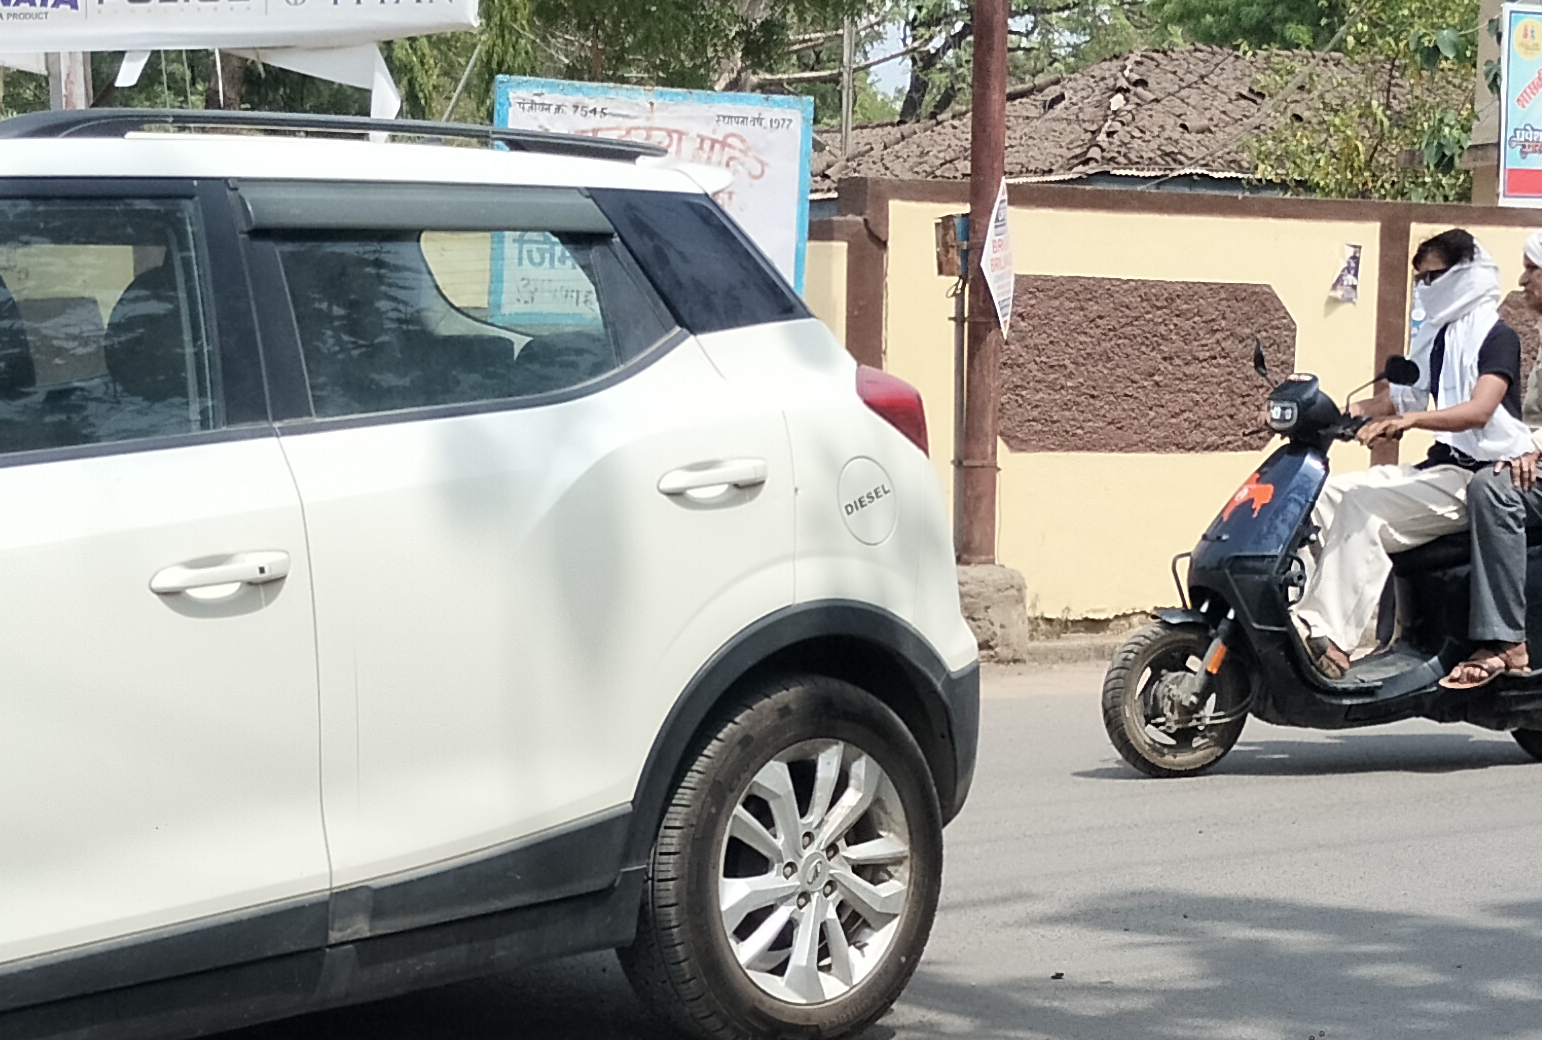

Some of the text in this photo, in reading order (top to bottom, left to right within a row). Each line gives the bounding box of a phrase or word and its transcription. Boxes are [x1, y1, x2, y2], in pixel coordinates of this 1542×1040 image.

[6, 12, 49, 21] PRODUCT
[769, 118, 793, 130] 1977
[844, 484, 890, 516] DIESEL
